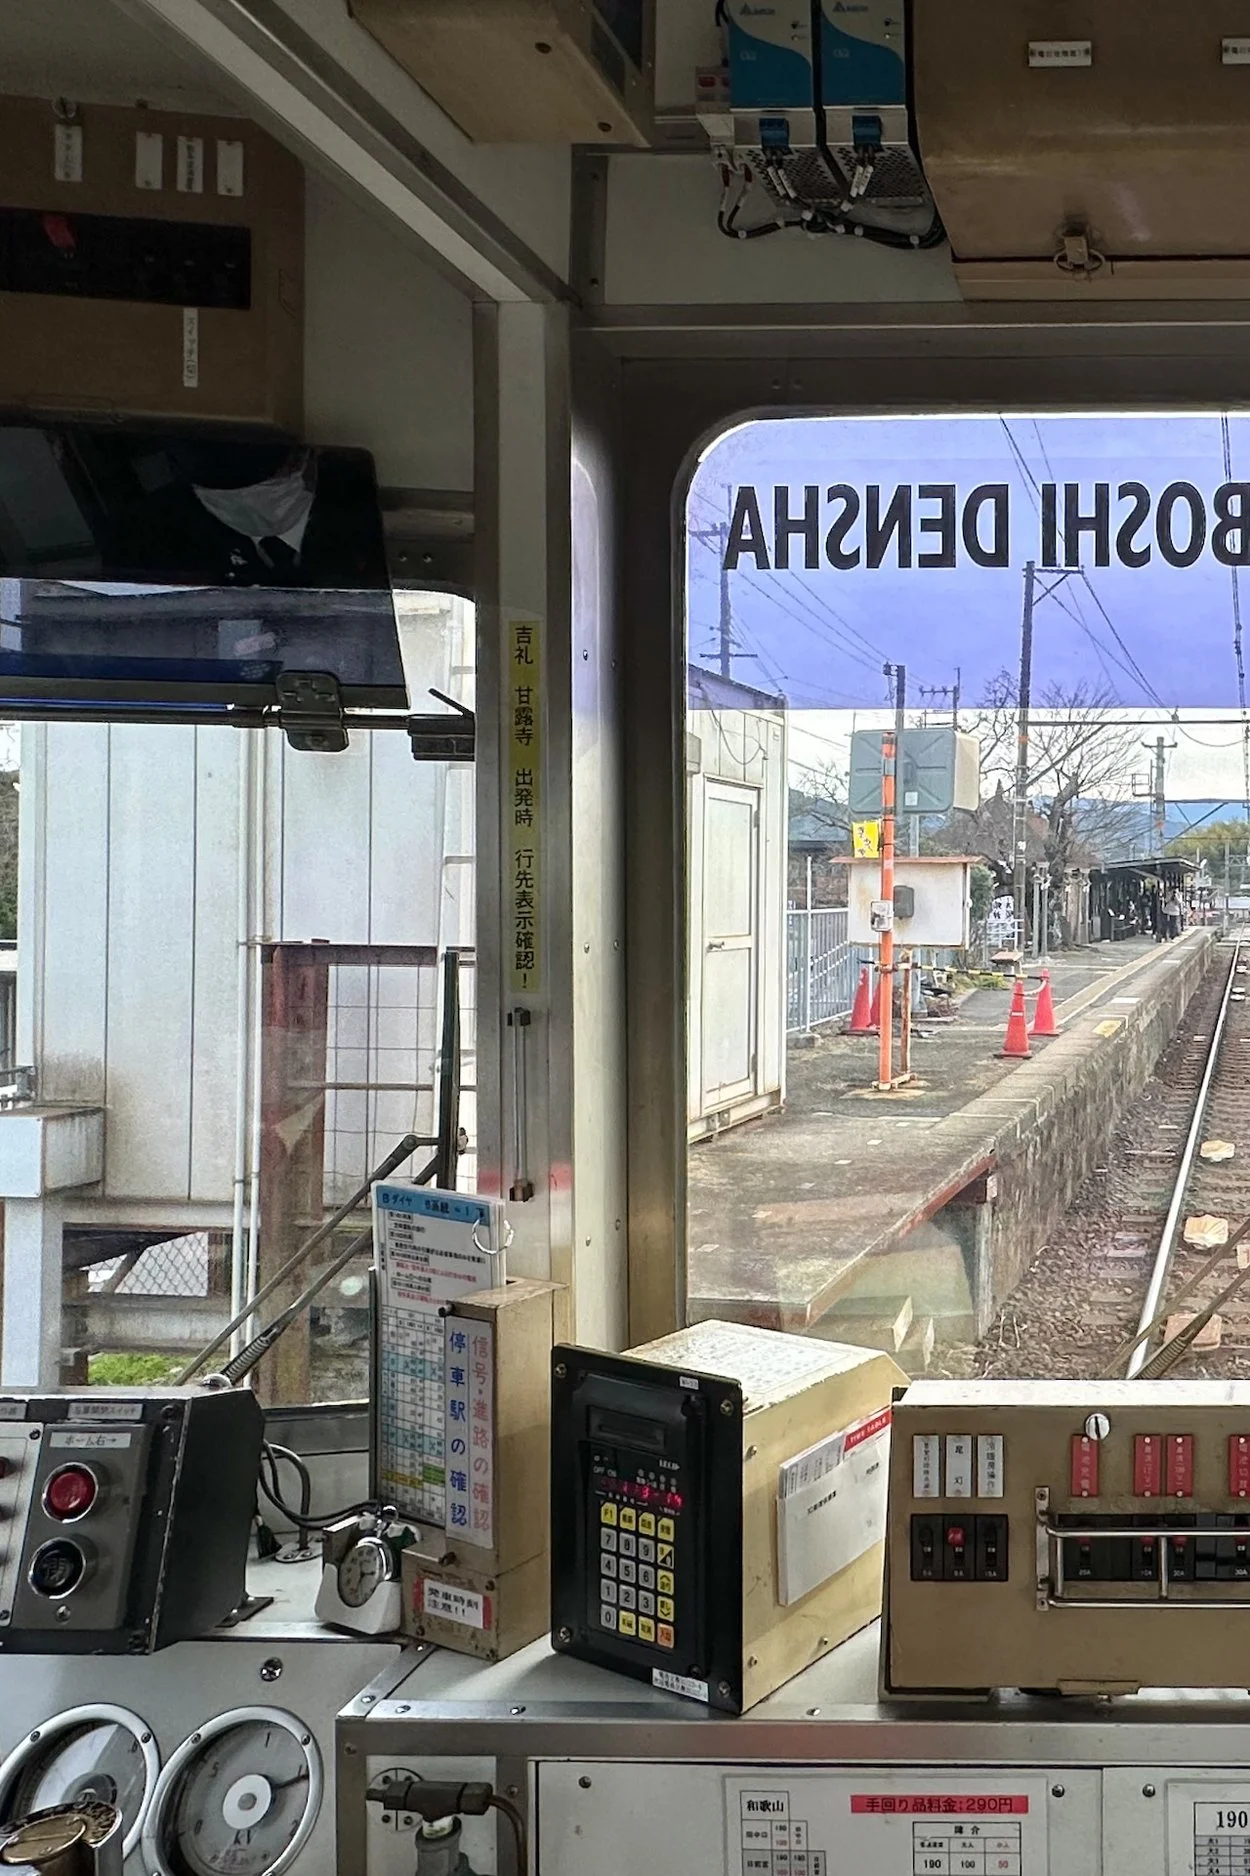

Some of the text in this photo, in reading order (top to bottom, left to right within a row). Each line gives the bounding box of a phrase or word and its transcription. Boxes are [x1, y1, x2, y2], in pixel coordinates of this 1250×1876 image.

[514, 626, 534, 665] 吉礼
[514, 686, 534, 747] 甘露寺
[514, 768, 534, 828] 出発時
[450, 1331, 467, 1527] 停車駅の確認
[472, 1336, 490, 1532] 信号・進路の確認
[427, 1599, 465, 1617] 注意!!
[428, 1587, 479, 1610] 発車時刻
[747, 1799, 785, 1812] 和歌山
[866, 1797, 1014, 1814] 手回り品料金:290円
[1217, 1810, 1248, 1829] 190
[924, 1860, 942, 1869] 190
[961, 1861, 977, 1869] 100
